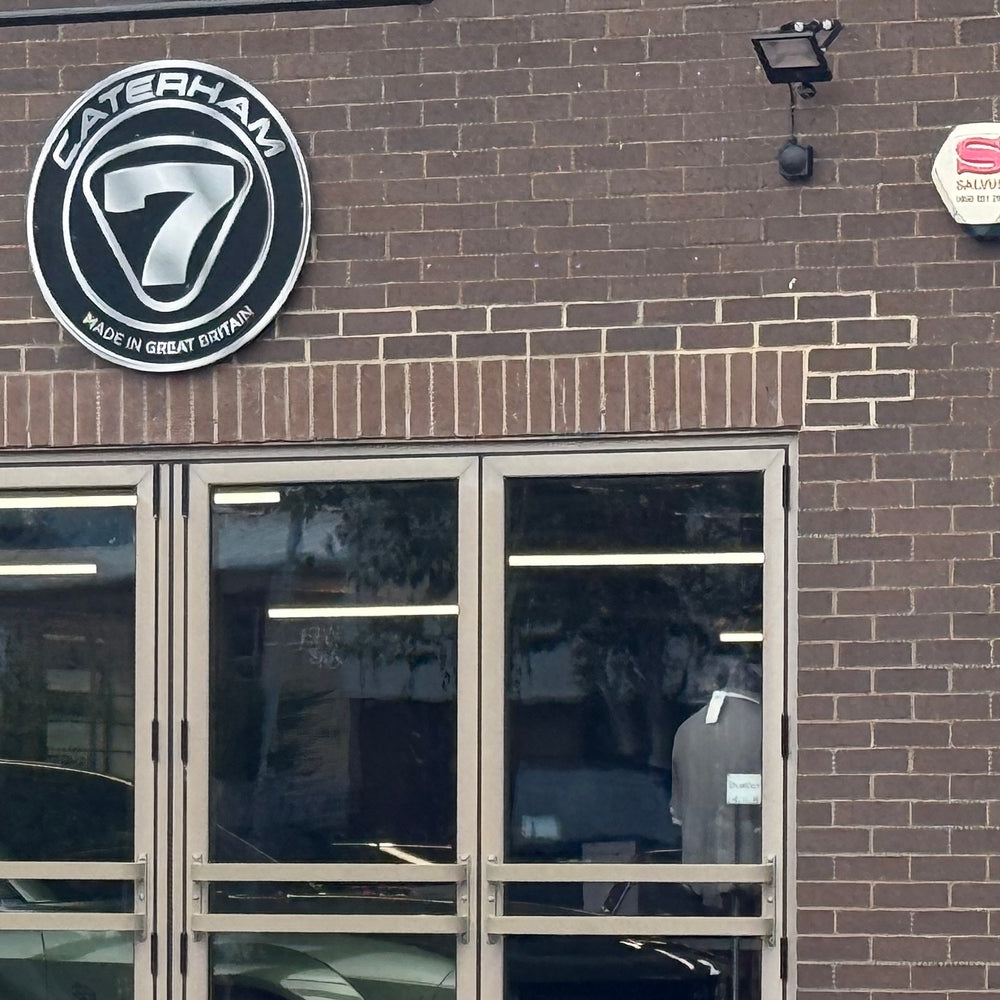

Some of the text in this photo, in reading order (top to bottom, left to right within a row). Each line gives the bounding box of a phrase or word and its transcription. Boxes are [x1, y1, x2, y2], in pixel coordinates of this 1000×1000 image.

[53, 72, 286, 170] CATERHAM
[104, 162, 234, 287] 7
[82, 304, 255, 355] MADE IN GREAT BRITAIN
